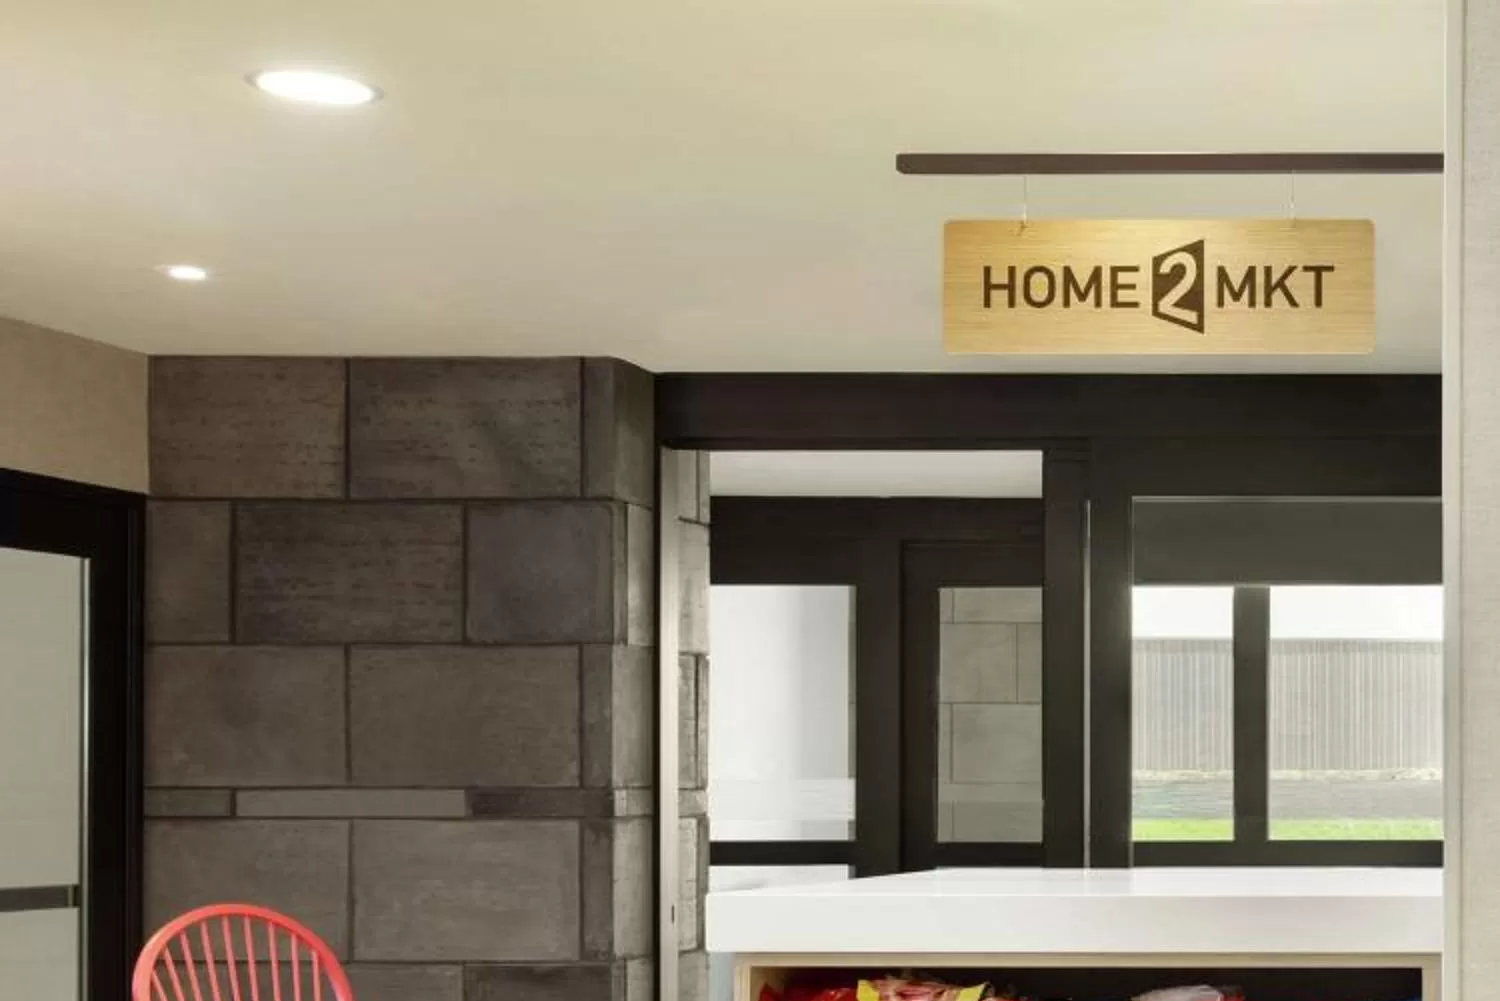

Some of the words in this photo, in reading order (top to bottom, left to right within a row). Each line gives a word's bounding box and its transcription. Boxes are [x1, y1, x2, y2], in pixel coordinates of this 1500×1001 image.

[982, 265, 1140, 309] HOME
[1155, 250, 1200, 326] 2
[1216, 265, 1335, 309] MKT
